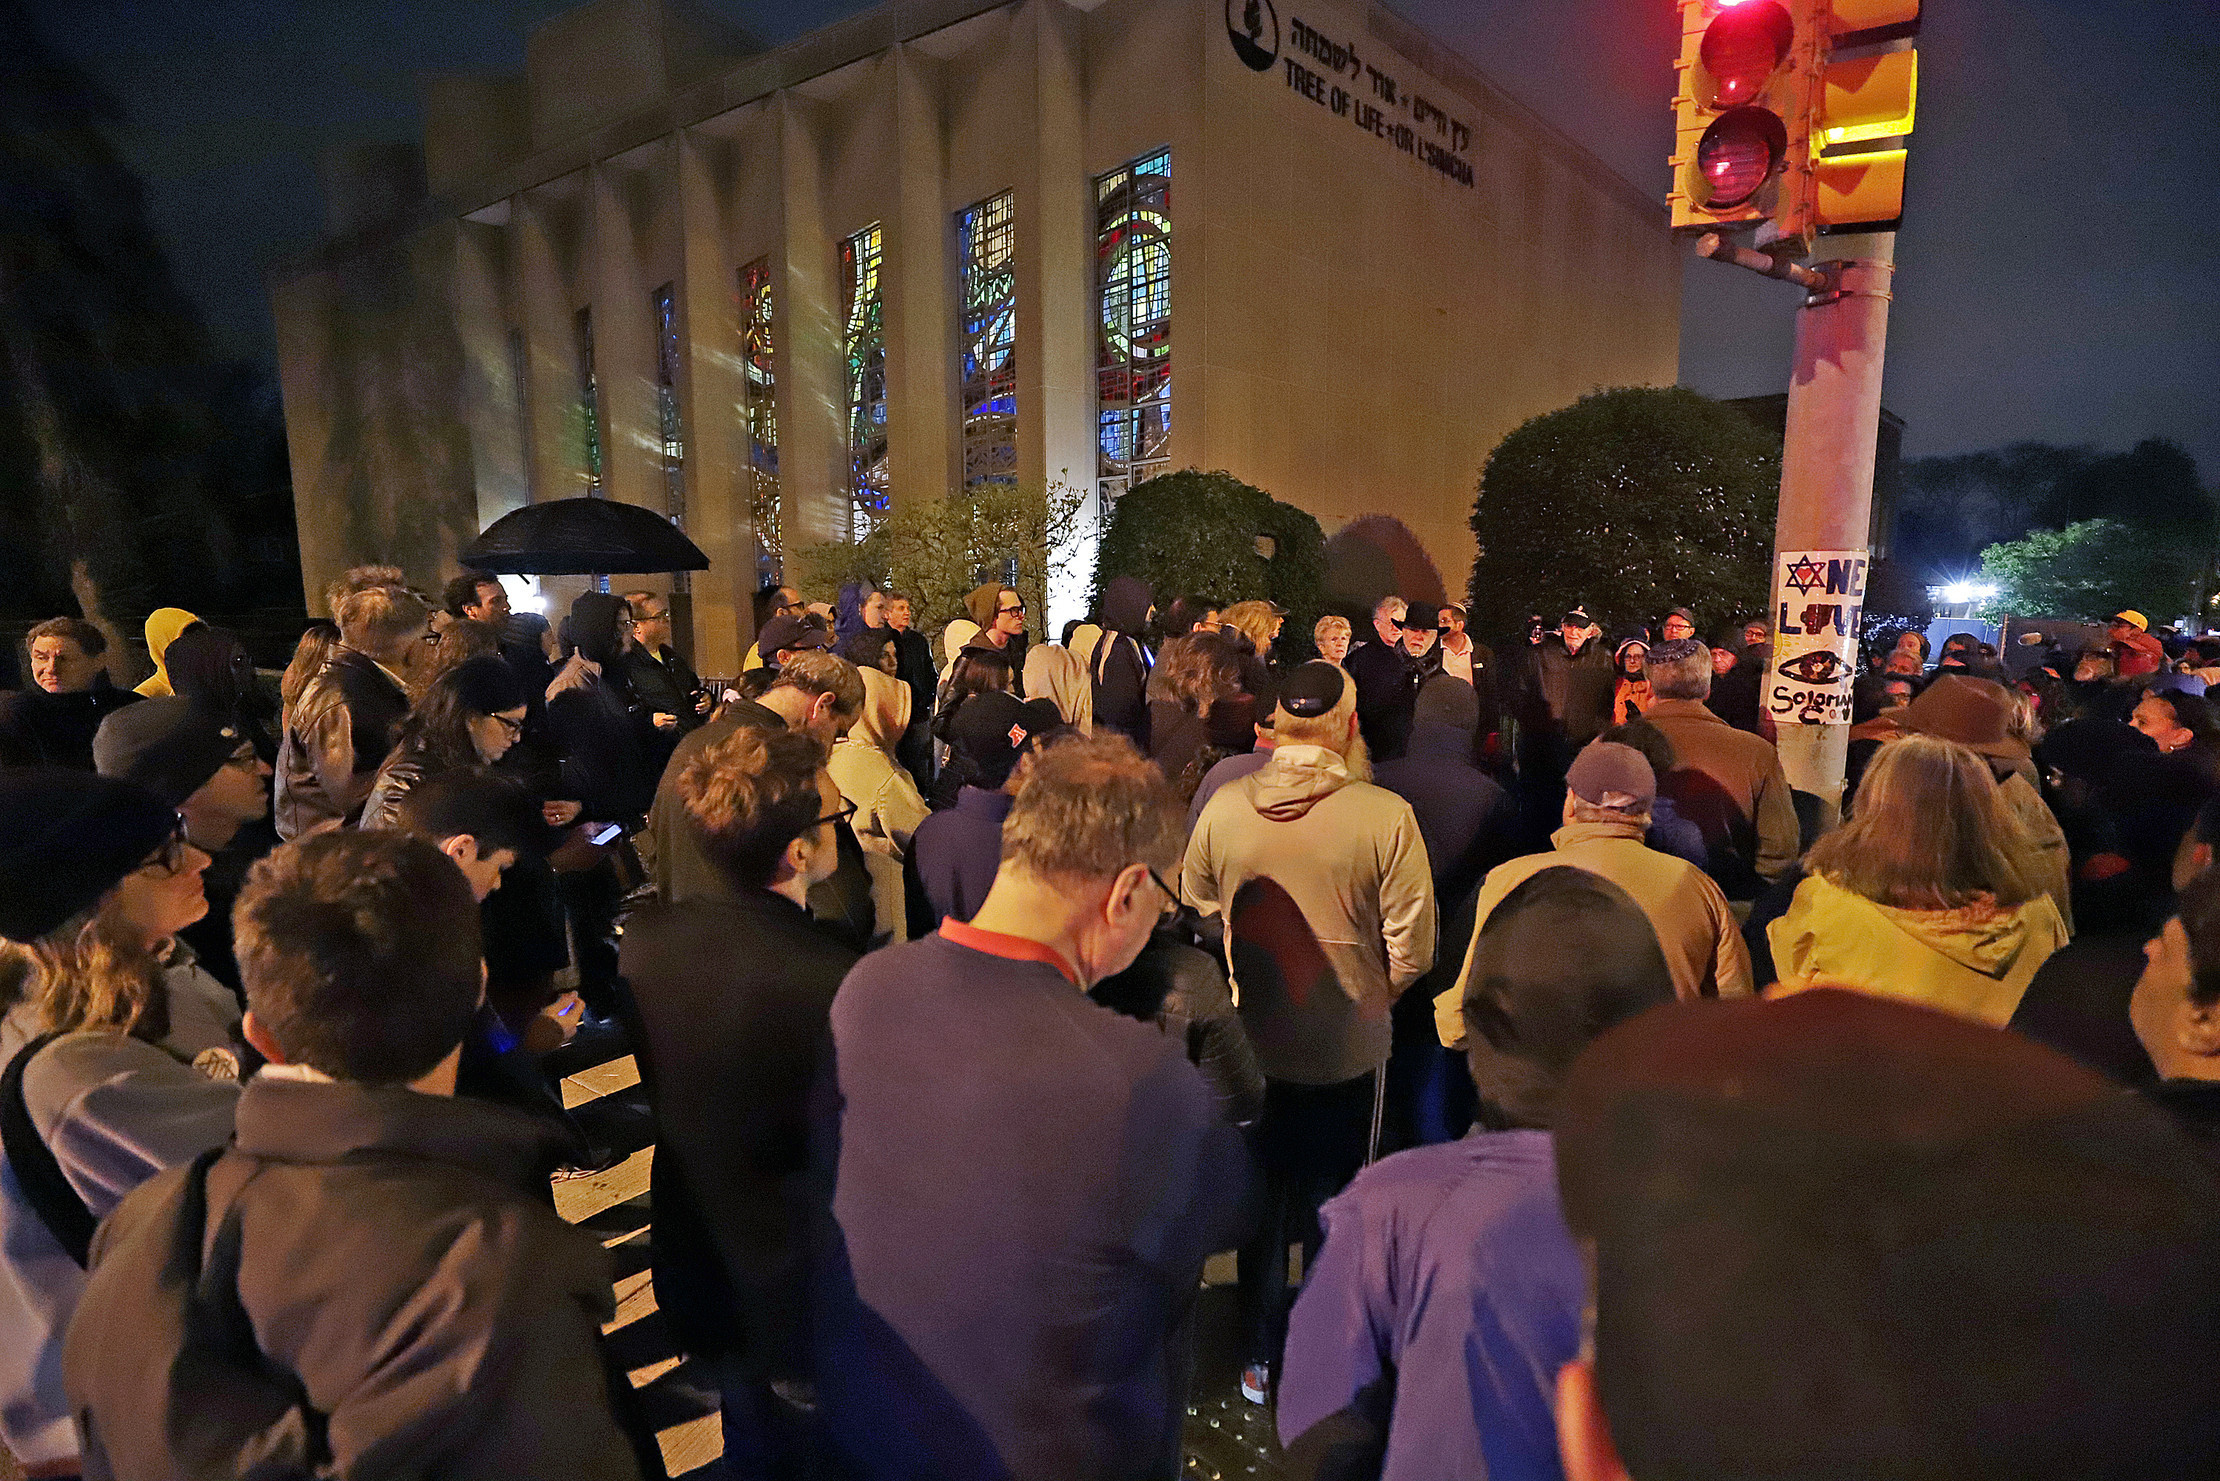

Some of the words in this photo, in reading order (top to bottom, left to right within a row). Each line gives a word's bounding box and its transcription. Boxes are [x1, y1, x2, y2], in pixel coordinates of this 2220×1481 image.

[1291, 16, 1361, 81] לשמחה
[1283, 56, 1326, 106] TREE
[1330, 85, 1351, 117] OF
[1354, 98, 1384, 139] LIFE
[1366, 63, 1398, 106] אור
